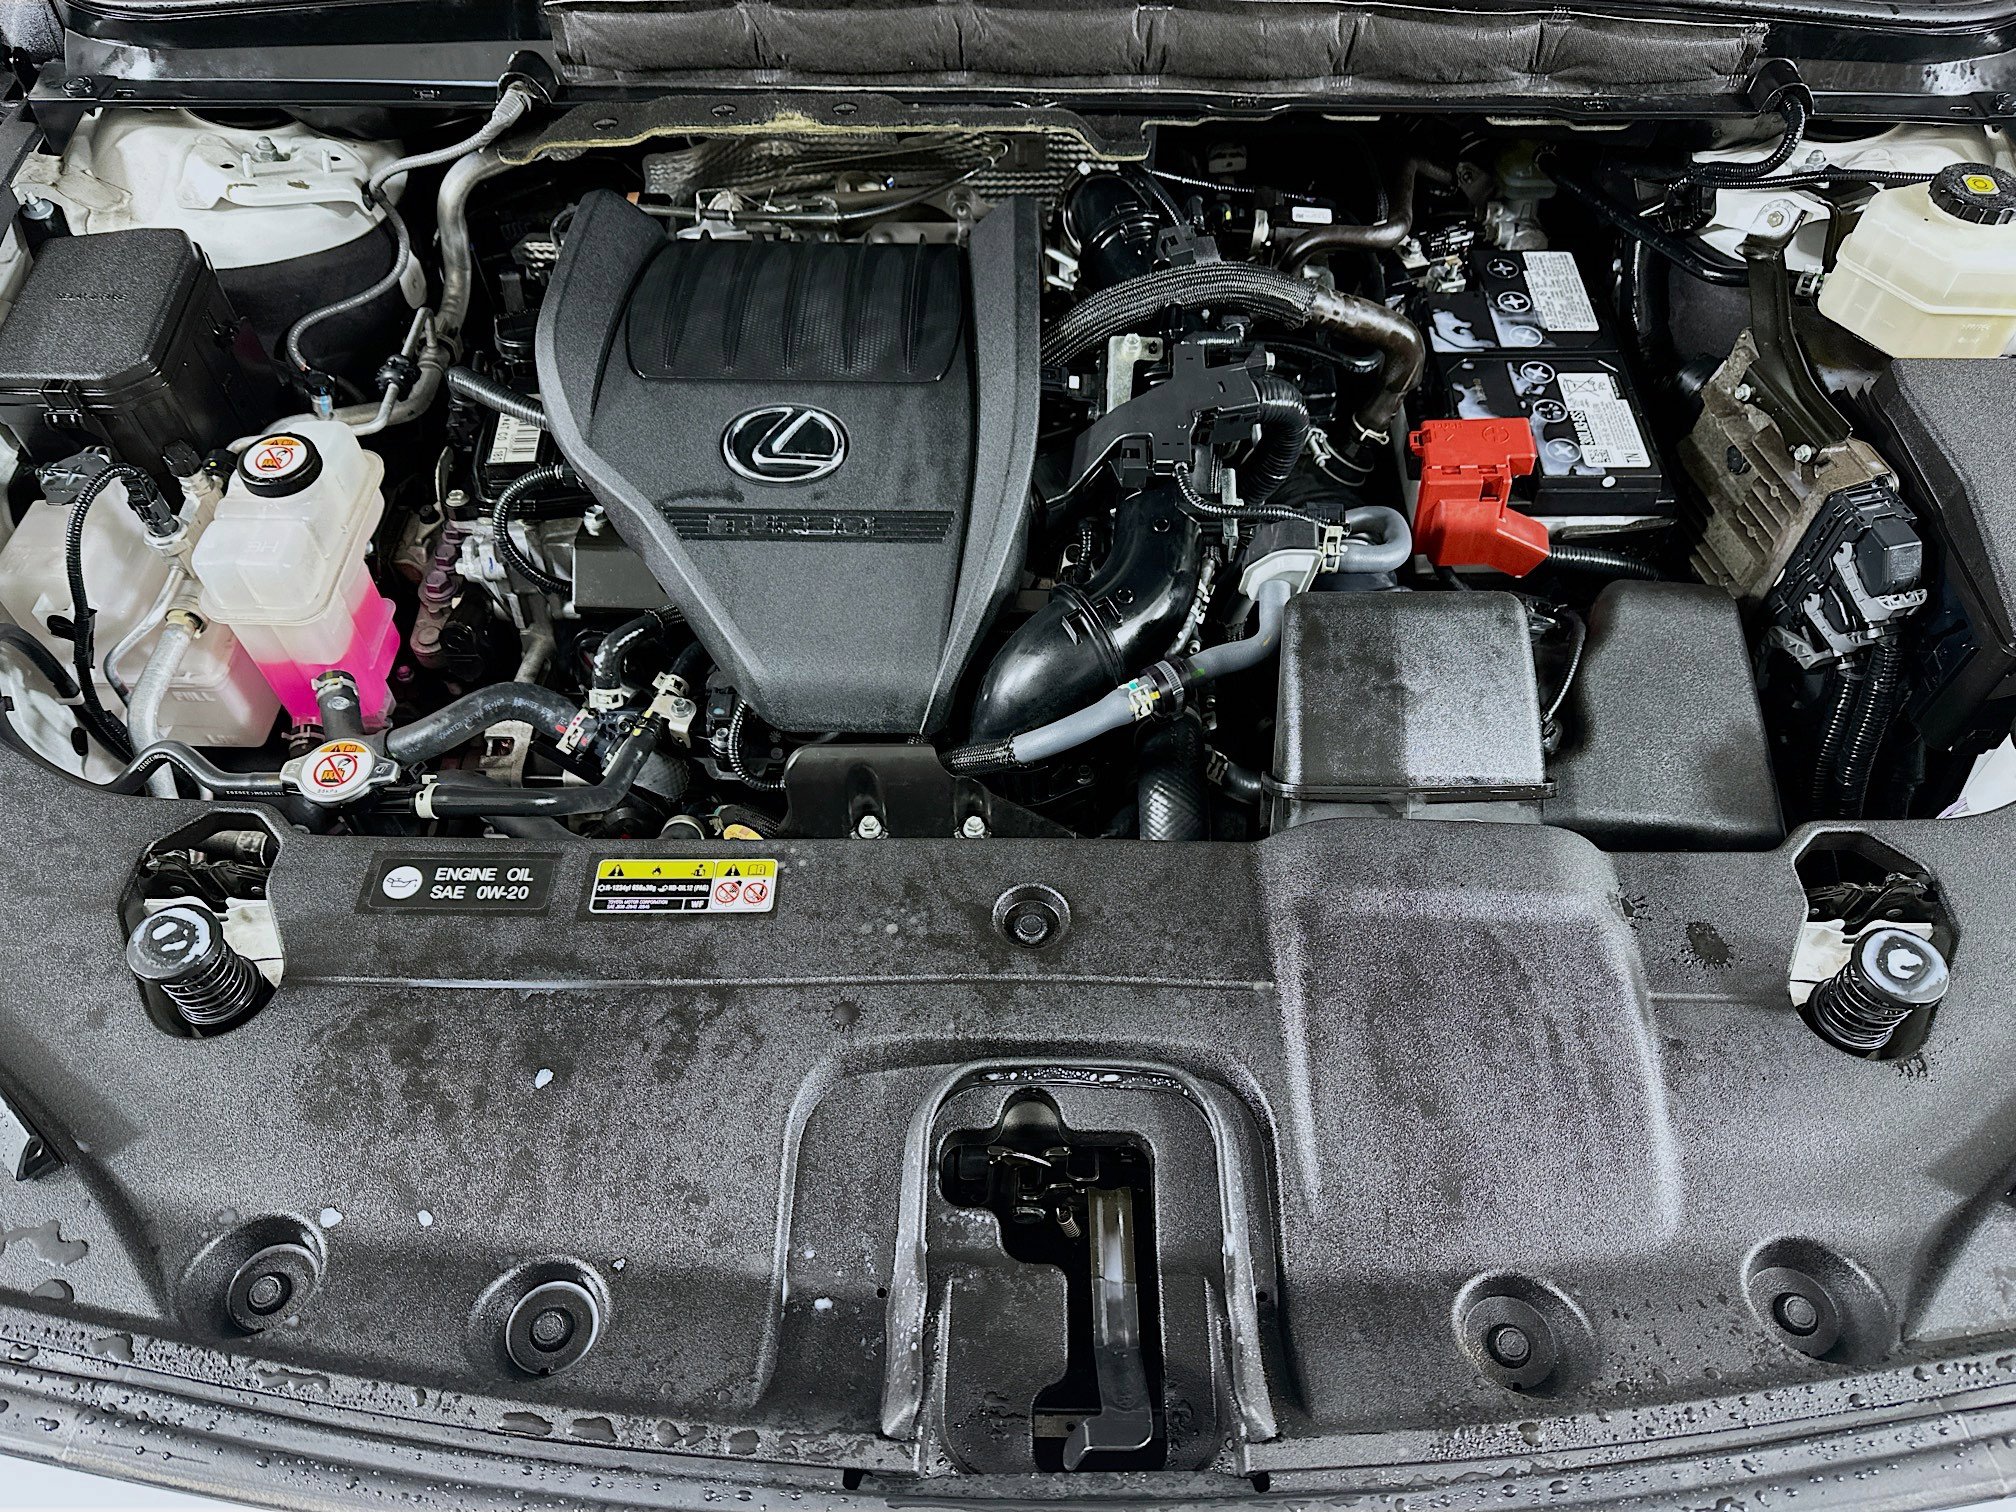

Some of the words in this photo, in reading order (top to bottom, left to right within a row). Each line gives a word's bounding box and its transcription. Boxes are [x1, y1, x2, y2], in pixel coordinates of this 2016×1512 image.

[434, 867, 498, 881] ENGINE
[506, 867, 534, 882] OIL
[430, 885, 467, 899] SAE
[476, 885, 530, 900] 0W-20
